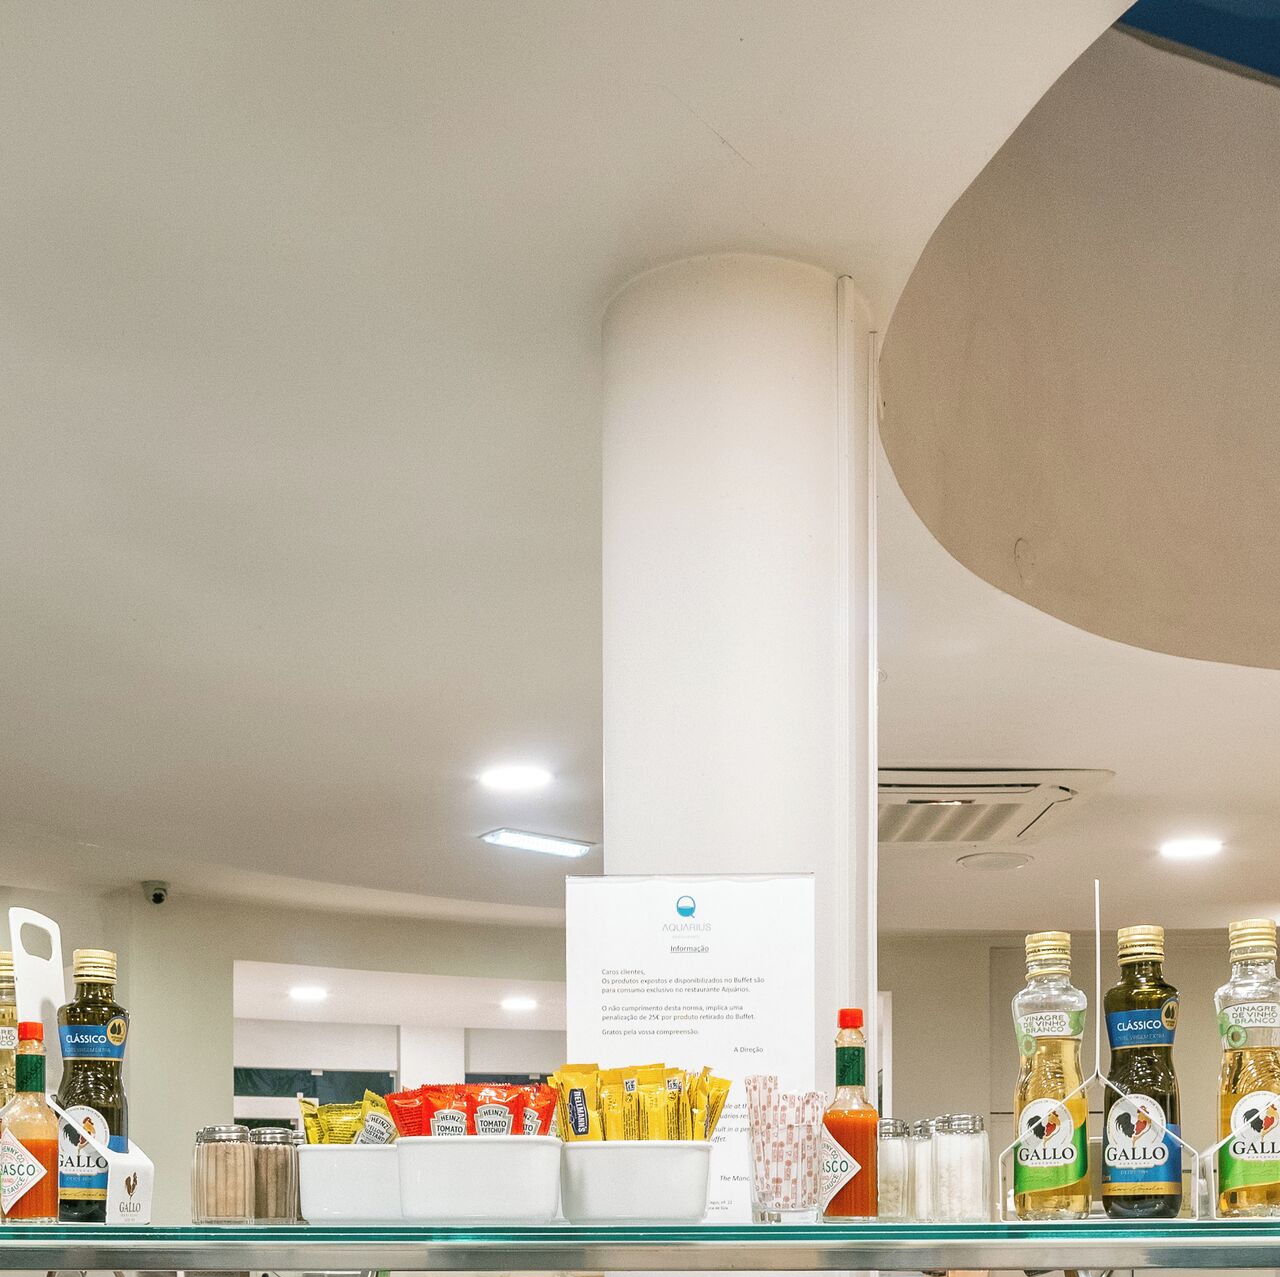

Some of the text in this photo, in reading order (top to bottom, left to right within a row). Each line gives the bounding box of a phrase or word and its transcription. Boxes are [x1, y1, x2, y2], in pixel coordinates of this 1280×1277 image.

[662, 923, 712, 932] AQUARIUS
[670, 945, 710, 953] Informação
[674, 977, 723, 985] disponibilizados
[705, 1004, 728, 1012] implica
[1233, 1004, 1277, 1013] VINAGRE
[601, 1013, 638, 1021] penalização
[1023, 1013, 1065, 1023] VINAGRE
[1246, 1010, 1278, 1018] VINHO
[1034, 1020, 1067, 1028] VINHO
[1234, 1017, 1277, 1025] BRANCO
[1117, 1019, 1162, 1032] CLÁSSICO
[623, 1028, 637, 1036] pela
[1025, 1026, 1064, 1034] BRANCO
[65, 1033, 107, 1044] CLÁSSICO
[483, 1109, 504, 1117] HEINZ
[440, 1114, 461, 1123] HEINZ
[371, 1116, 389, 1130] HEINZ
[479, 1120, 507, 1128] TOMATO
[436, 1125, 464, 1133] TOMATO
[1019, 1147, 1074, 1162] GALLO
[1106, 1146, 1166, 1161] GALLO
[1, 1163, 36, 1176] ASCO
[119, 1201, 142, 1213] GALLO
